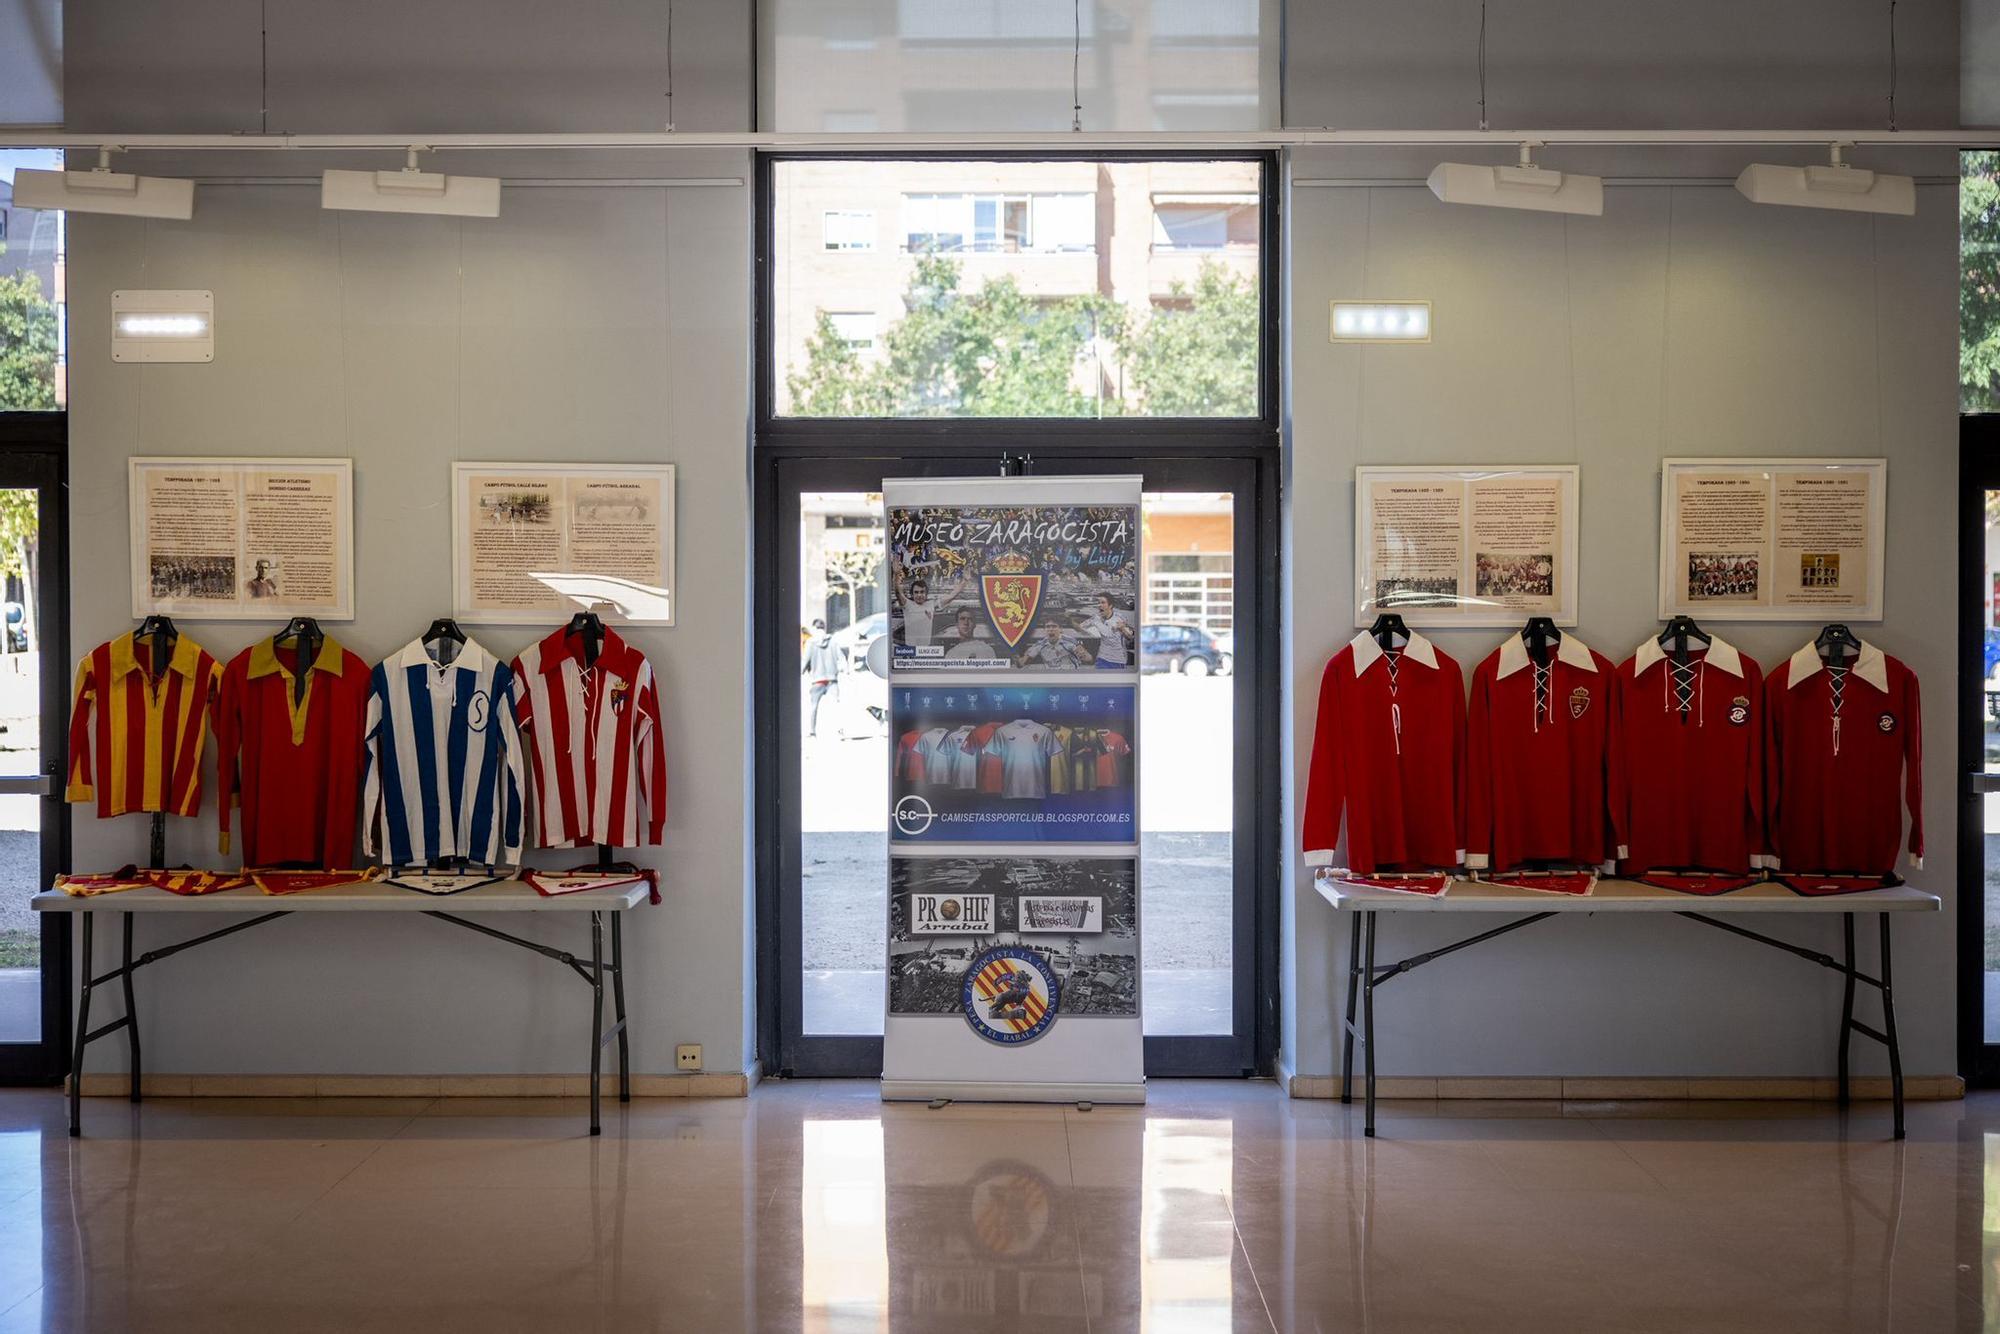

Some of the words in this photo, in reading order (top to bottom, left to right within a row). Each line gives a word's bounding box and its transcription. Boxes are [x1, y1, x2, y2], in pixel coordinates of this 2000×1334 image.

[895, 522, 963, 545] MUSEO
[970, 520, 1128, 544] ZARAGOCISTA
[1065, 550, 1081, 568] by
[1087, 550, 1126, 569] Luigi
[941, 812, 1130, 823] CAMISETASSPORTCLUB.BLOGSPOT.COM.ES
[918, 923, 989, 931] Arrabal
[965, 951, 1015, 993] ZARAGOCISTA
[986, 1030, 998, 1039] EL
[1003, 1031, 1031, 1041] RABAL
